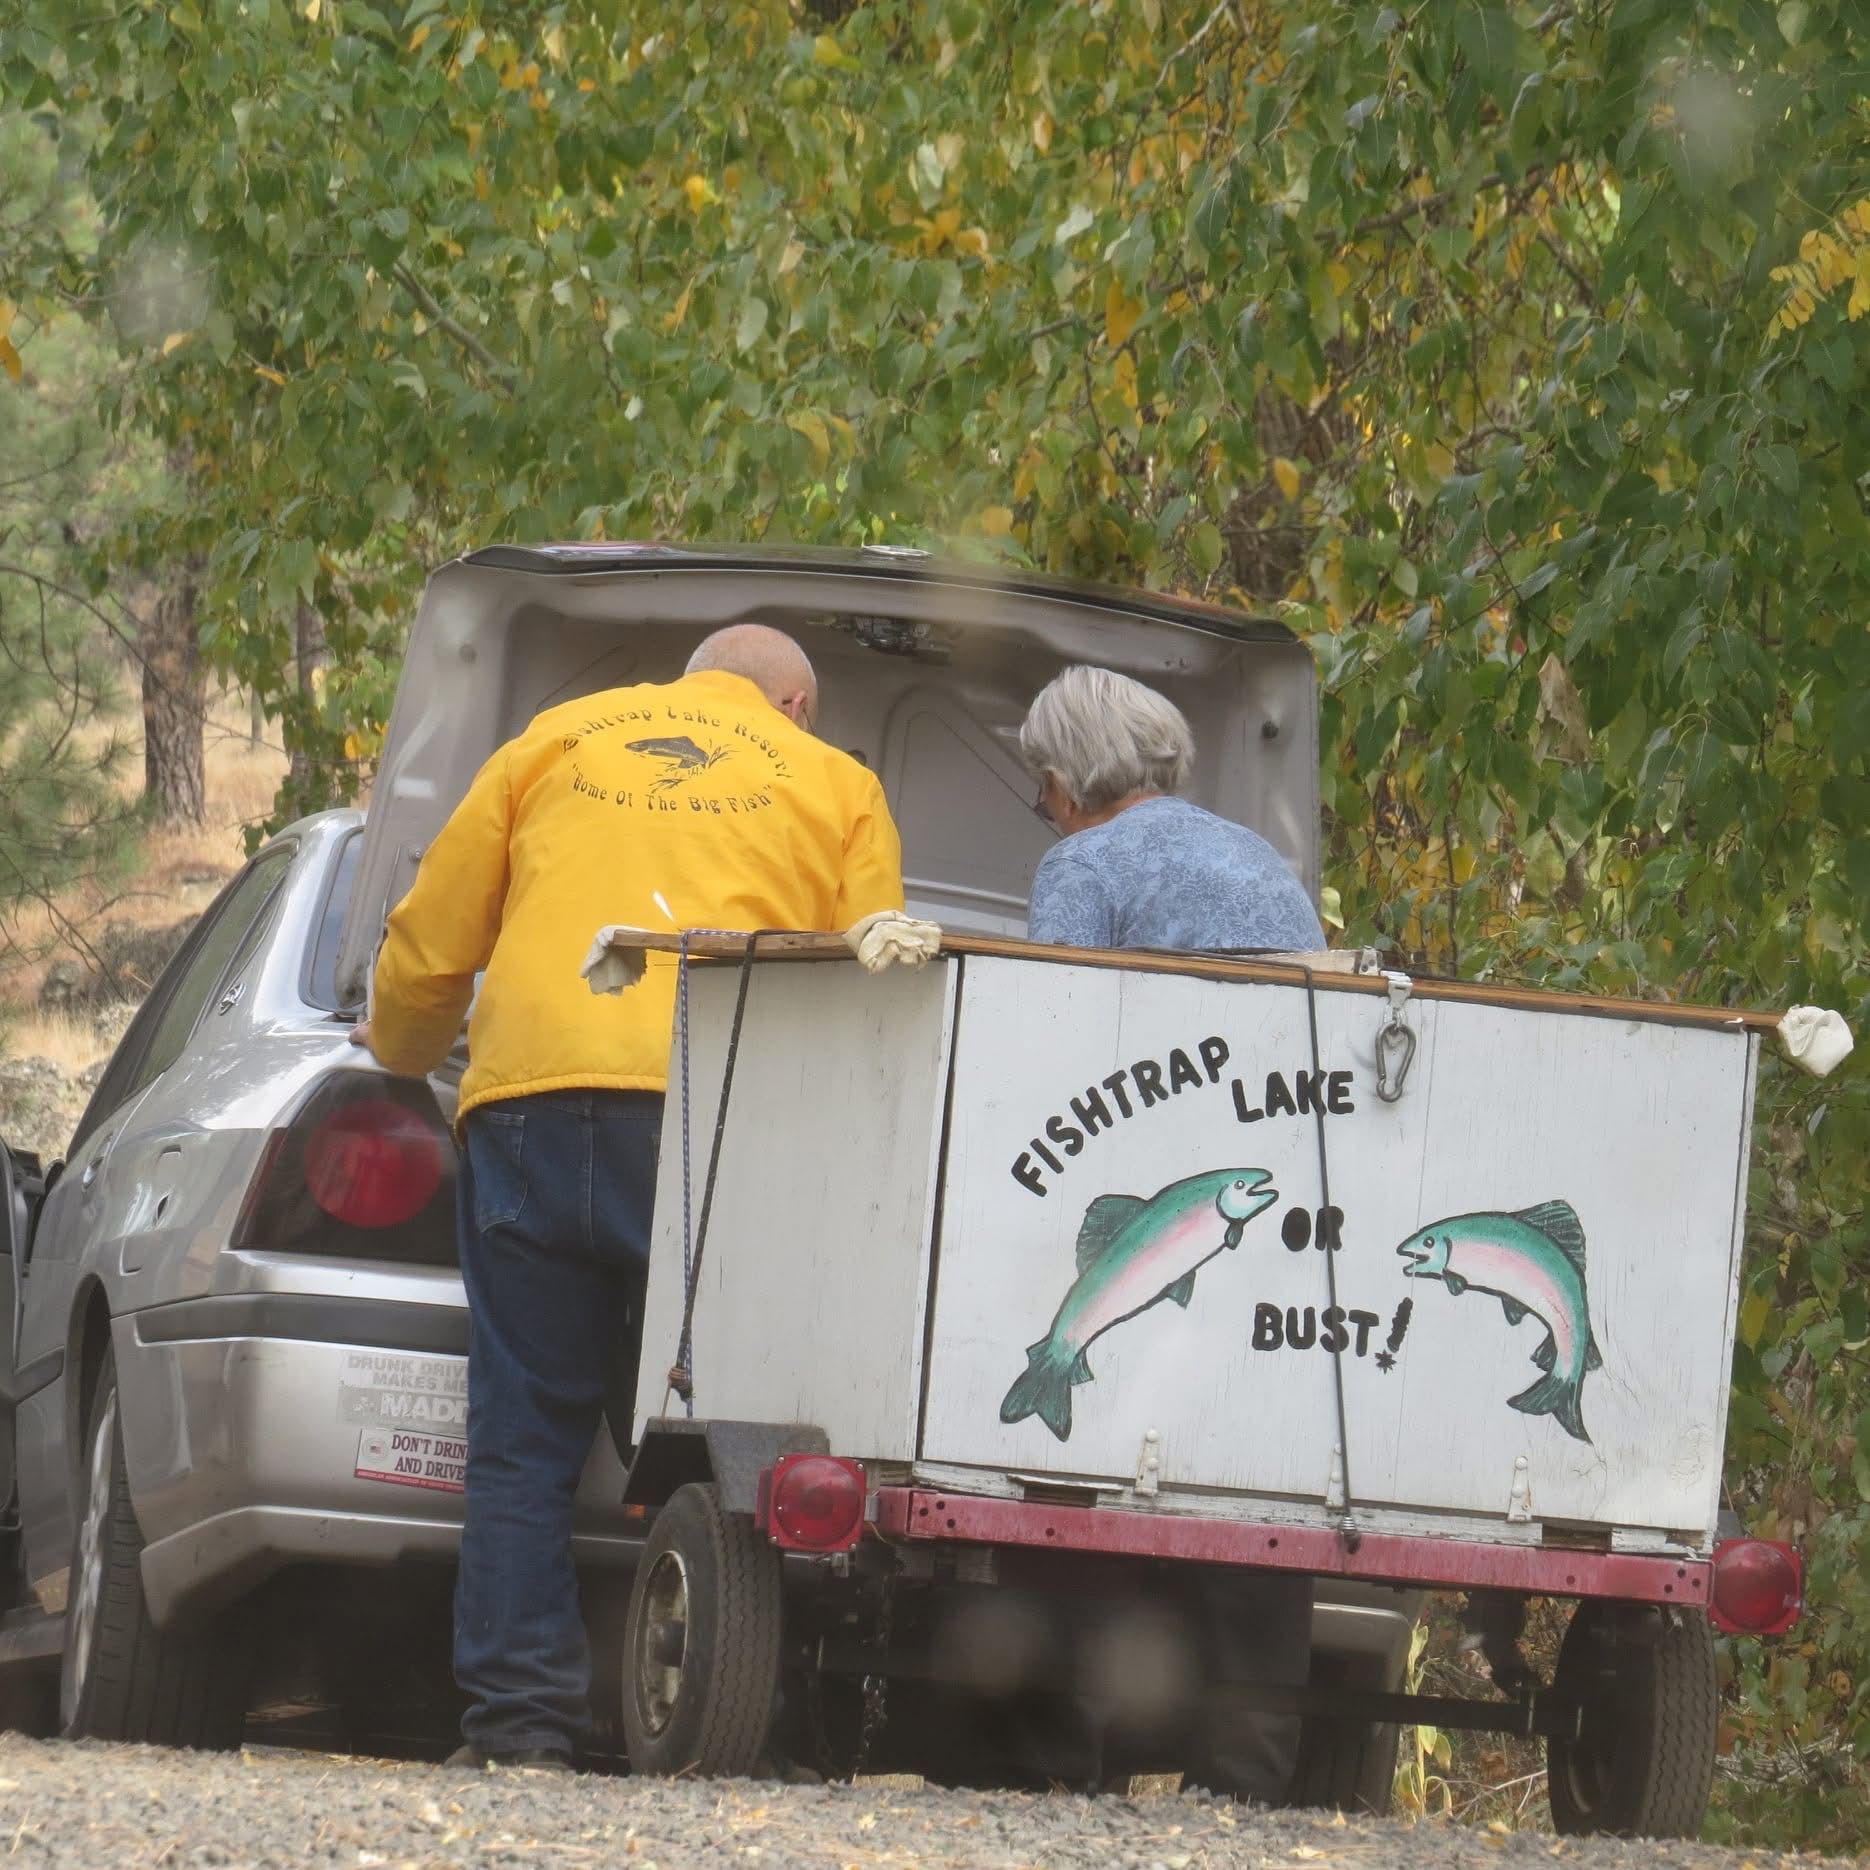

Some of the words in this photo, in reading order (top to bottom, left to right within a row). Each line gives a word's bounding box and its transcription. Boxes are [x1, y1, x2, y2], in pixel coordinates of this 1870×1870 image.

[665, 705, 721, 727] Lake
[734, 721, 794, 779] Resort
[645, 793, 678, 811] The
[688, 796, 721, 814] Big
[1010, 1036, 1230, 1198] FISHTRAP
[1231, 1069, 1355, 1123] LAKE
[1281, 1205, 1345, 1252] OR
[1251, 1297, 1413, 1374] BUST!
[348, 1355, 415, 1374] DRUNK
[372, 1371, 437, 1391] MAKES
[391, 1434, 432, 1455] DON'T
[433, 1440, 469, 1460] DRIN
[394, 1456, 423, 1474] AND
[424, 1460, 465, 1481] DRIVE
